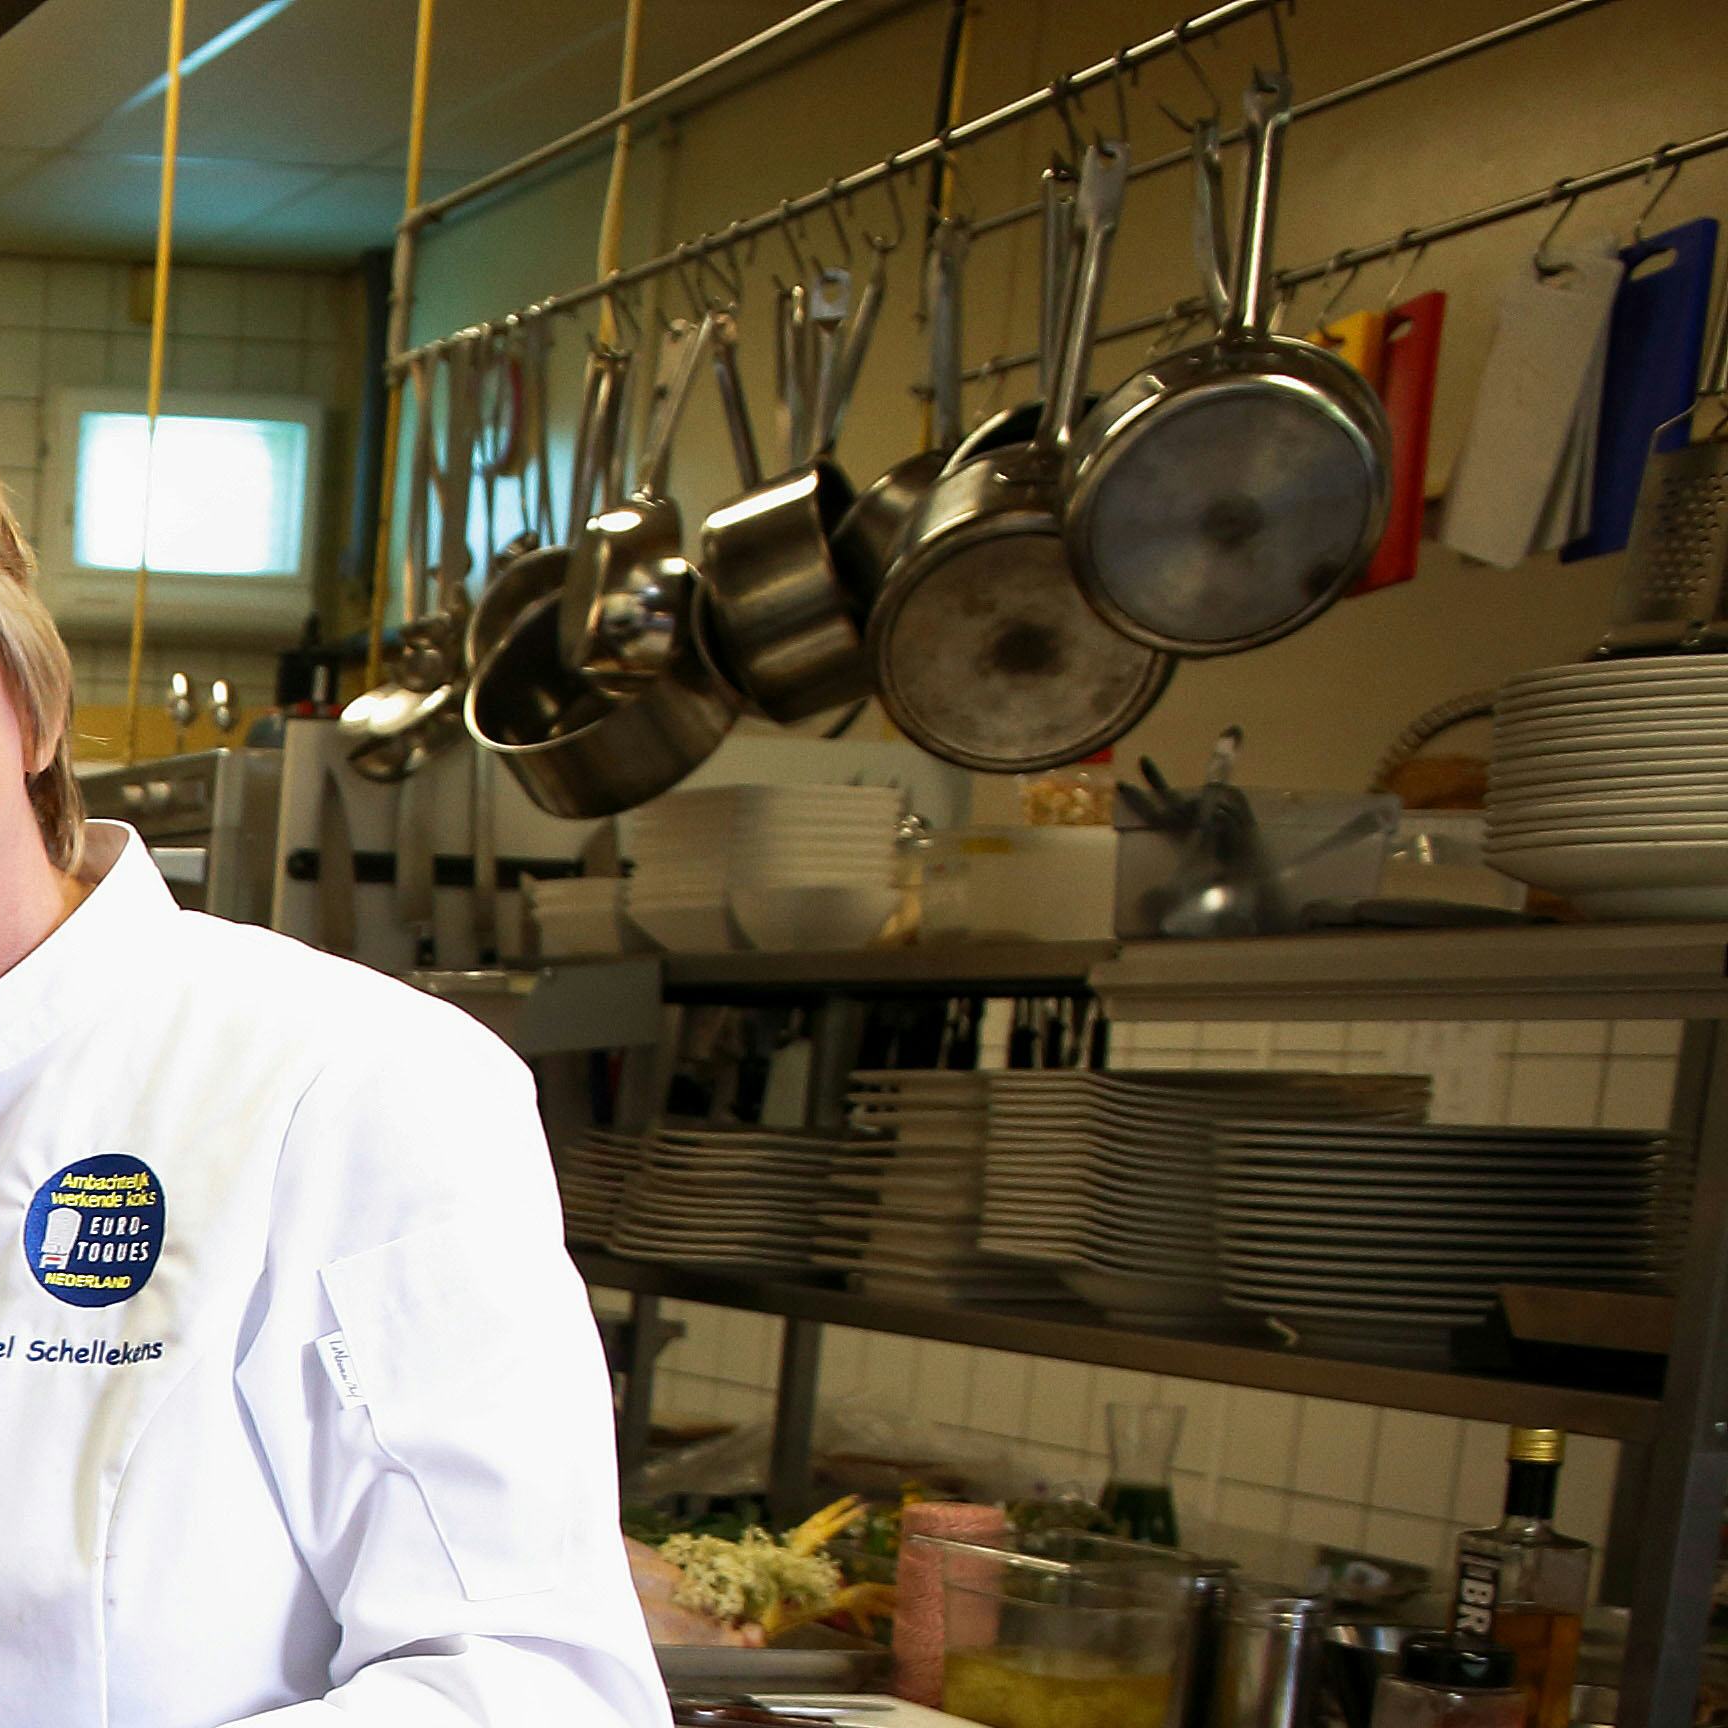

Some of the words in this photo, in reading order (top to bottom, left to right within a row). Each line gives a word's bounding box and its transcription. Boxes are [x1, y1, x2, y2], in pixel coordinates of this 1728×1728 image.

[51, 1191, 123, 1207] werkende
[125, 1191, 156, 1207] koks
[89, 1216, 150, 1236] EURO-
[76, 1241, 149, 1262] TOQUES
[44, 1272, 131, 1288] NEDERLAND
[26, 1338, 164, 1365] Schellekens
